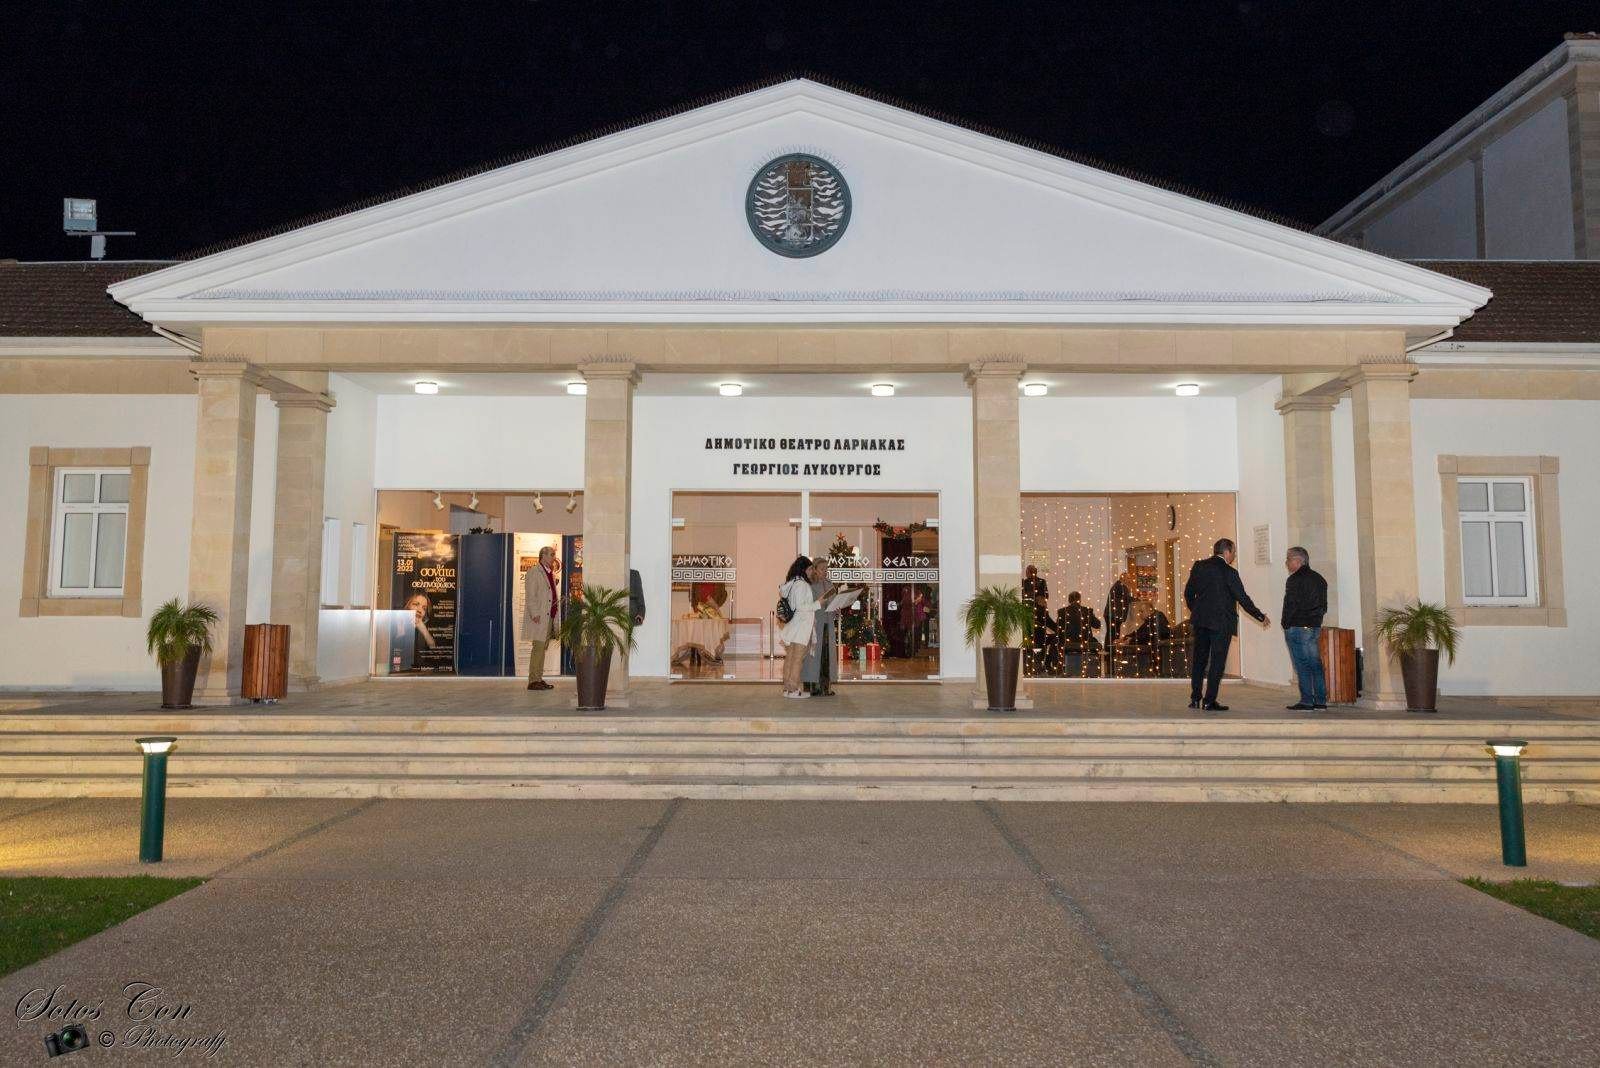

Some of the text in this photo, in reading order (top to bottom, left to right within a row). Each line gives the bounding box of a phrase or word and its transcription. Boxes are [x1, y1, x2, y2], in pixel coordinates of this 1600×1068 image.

[705, 438, 905, 451] ΔΗΜΟΤΙΚΟ ΘΕΑΤΡΟ ΛΑΡΝΑΚΑΣ
[733, 463, 881, 476] ΓΕΩΡΓΙΟΣ ΛΥΚΟΥΡΓΟΣ
[676, 555, 733, 567] ΔΗΜΟΤΙΚΟ
[826, 556, 930, 568] ΜΟΤΙΚΟ ΘΕΑΤΡΟ
[420, 565, 455, 577] σονάτα
